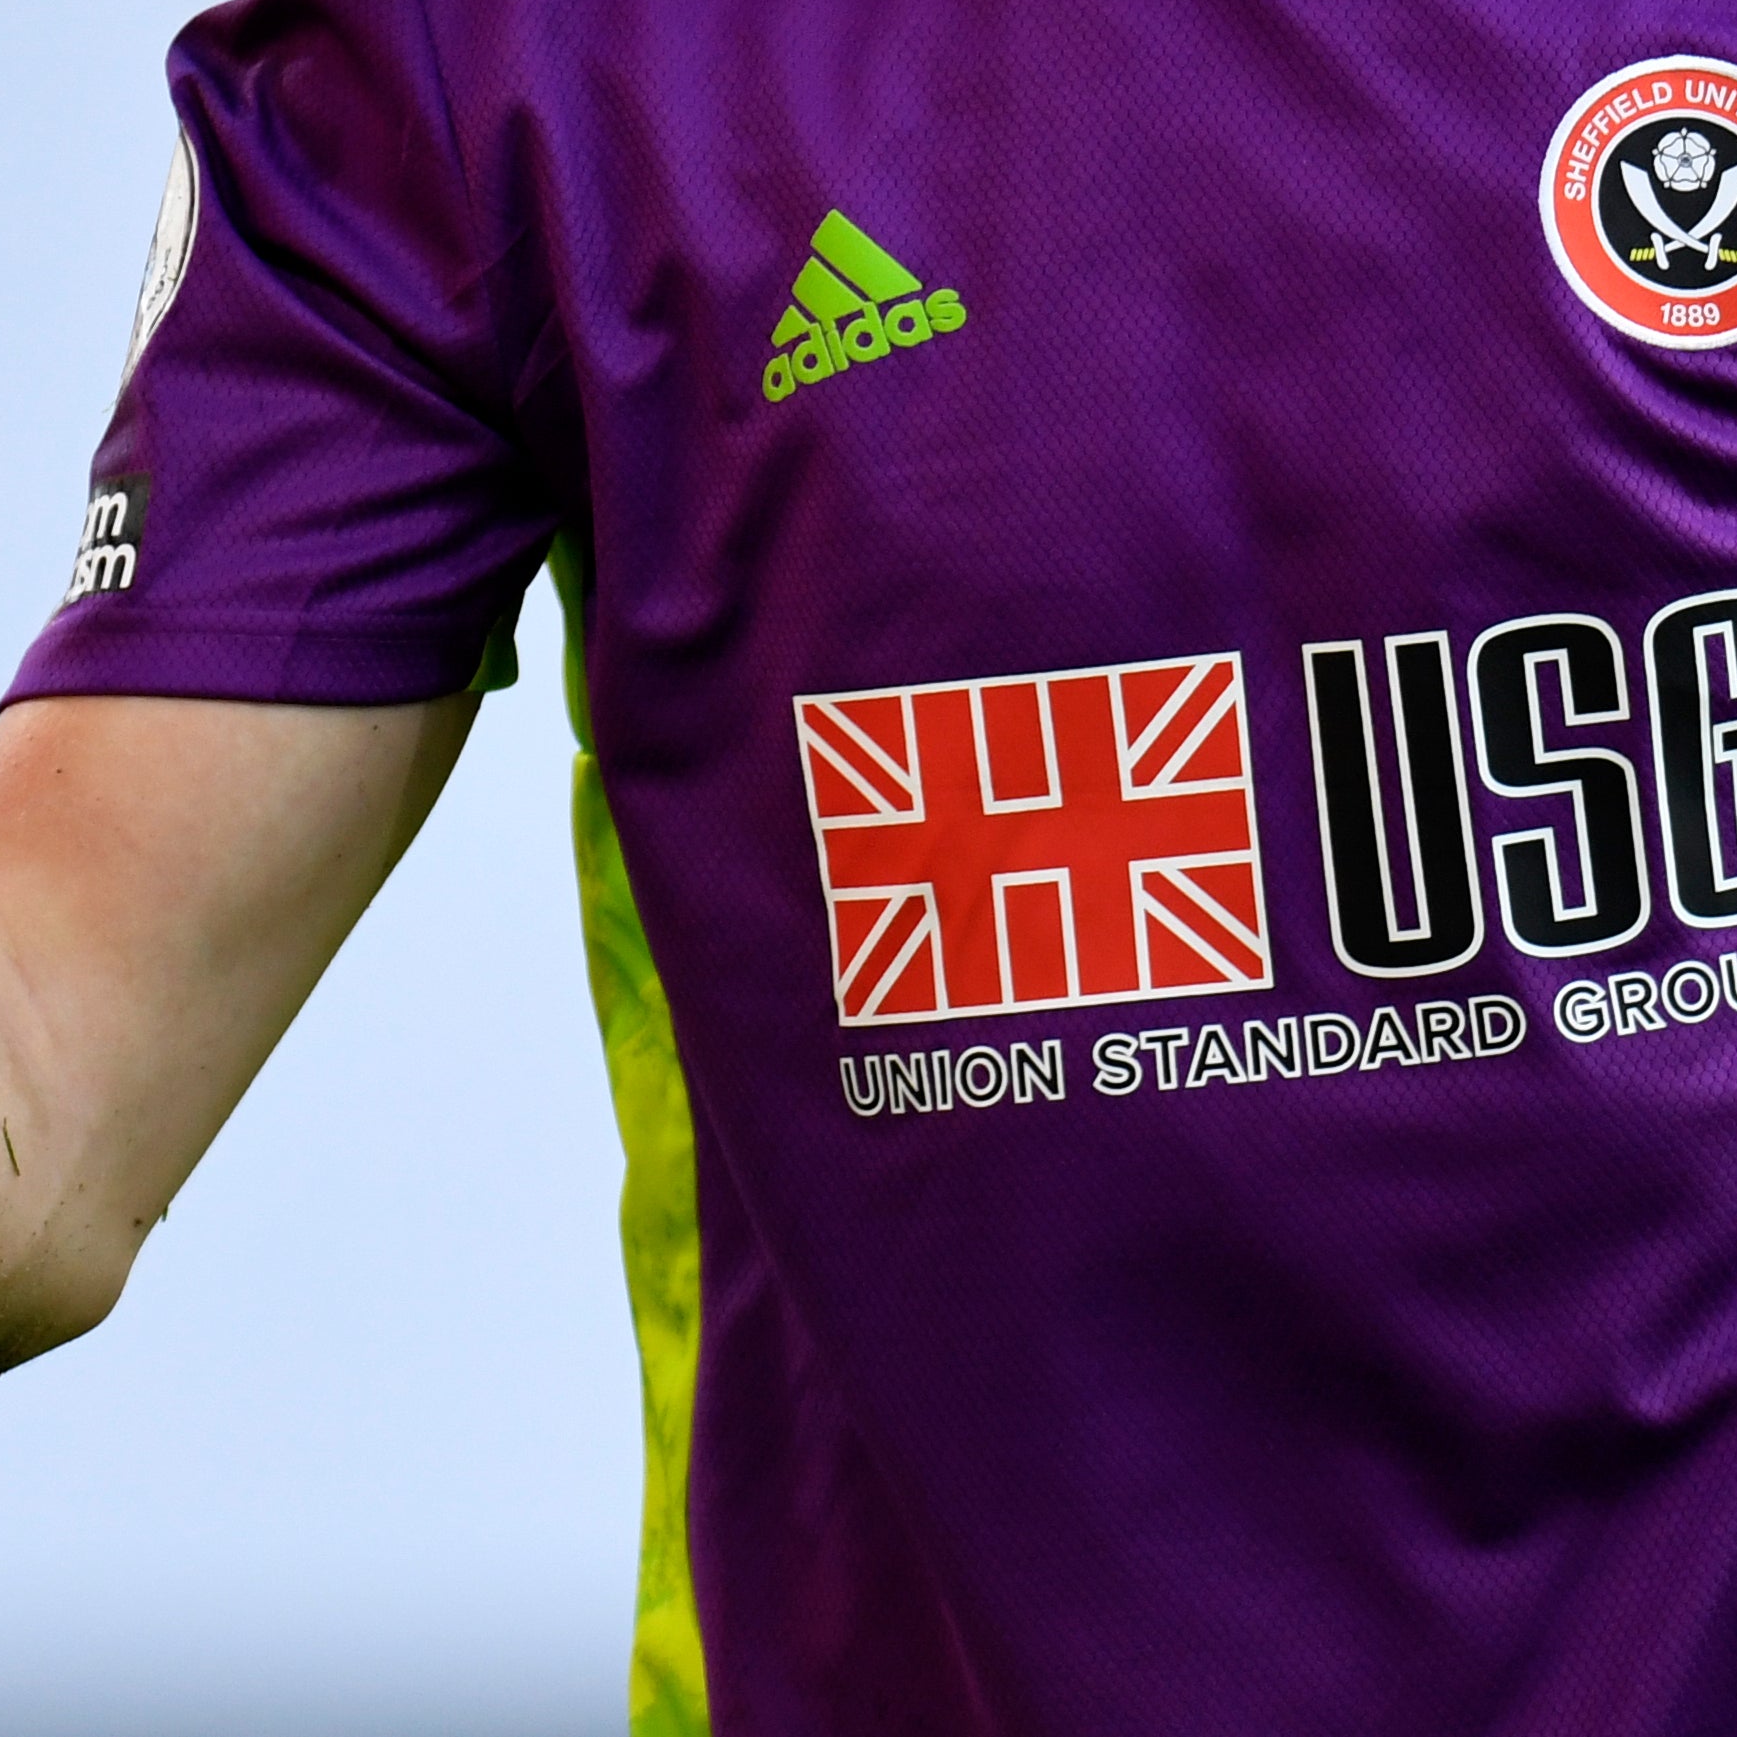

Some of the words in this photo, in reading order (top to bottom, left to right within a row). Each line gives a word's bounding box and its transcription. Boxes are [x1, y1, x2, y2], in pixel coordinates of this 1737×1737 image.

[1564, 81, 1673, 201] SHEFFIELD
[762, 288, 967, 402] adidas
[1660, 302, 1720, 327] 1889
[839, 1039, 1065, 1116] UNION
[1092, 994, 1527, 1095] STANDARD
